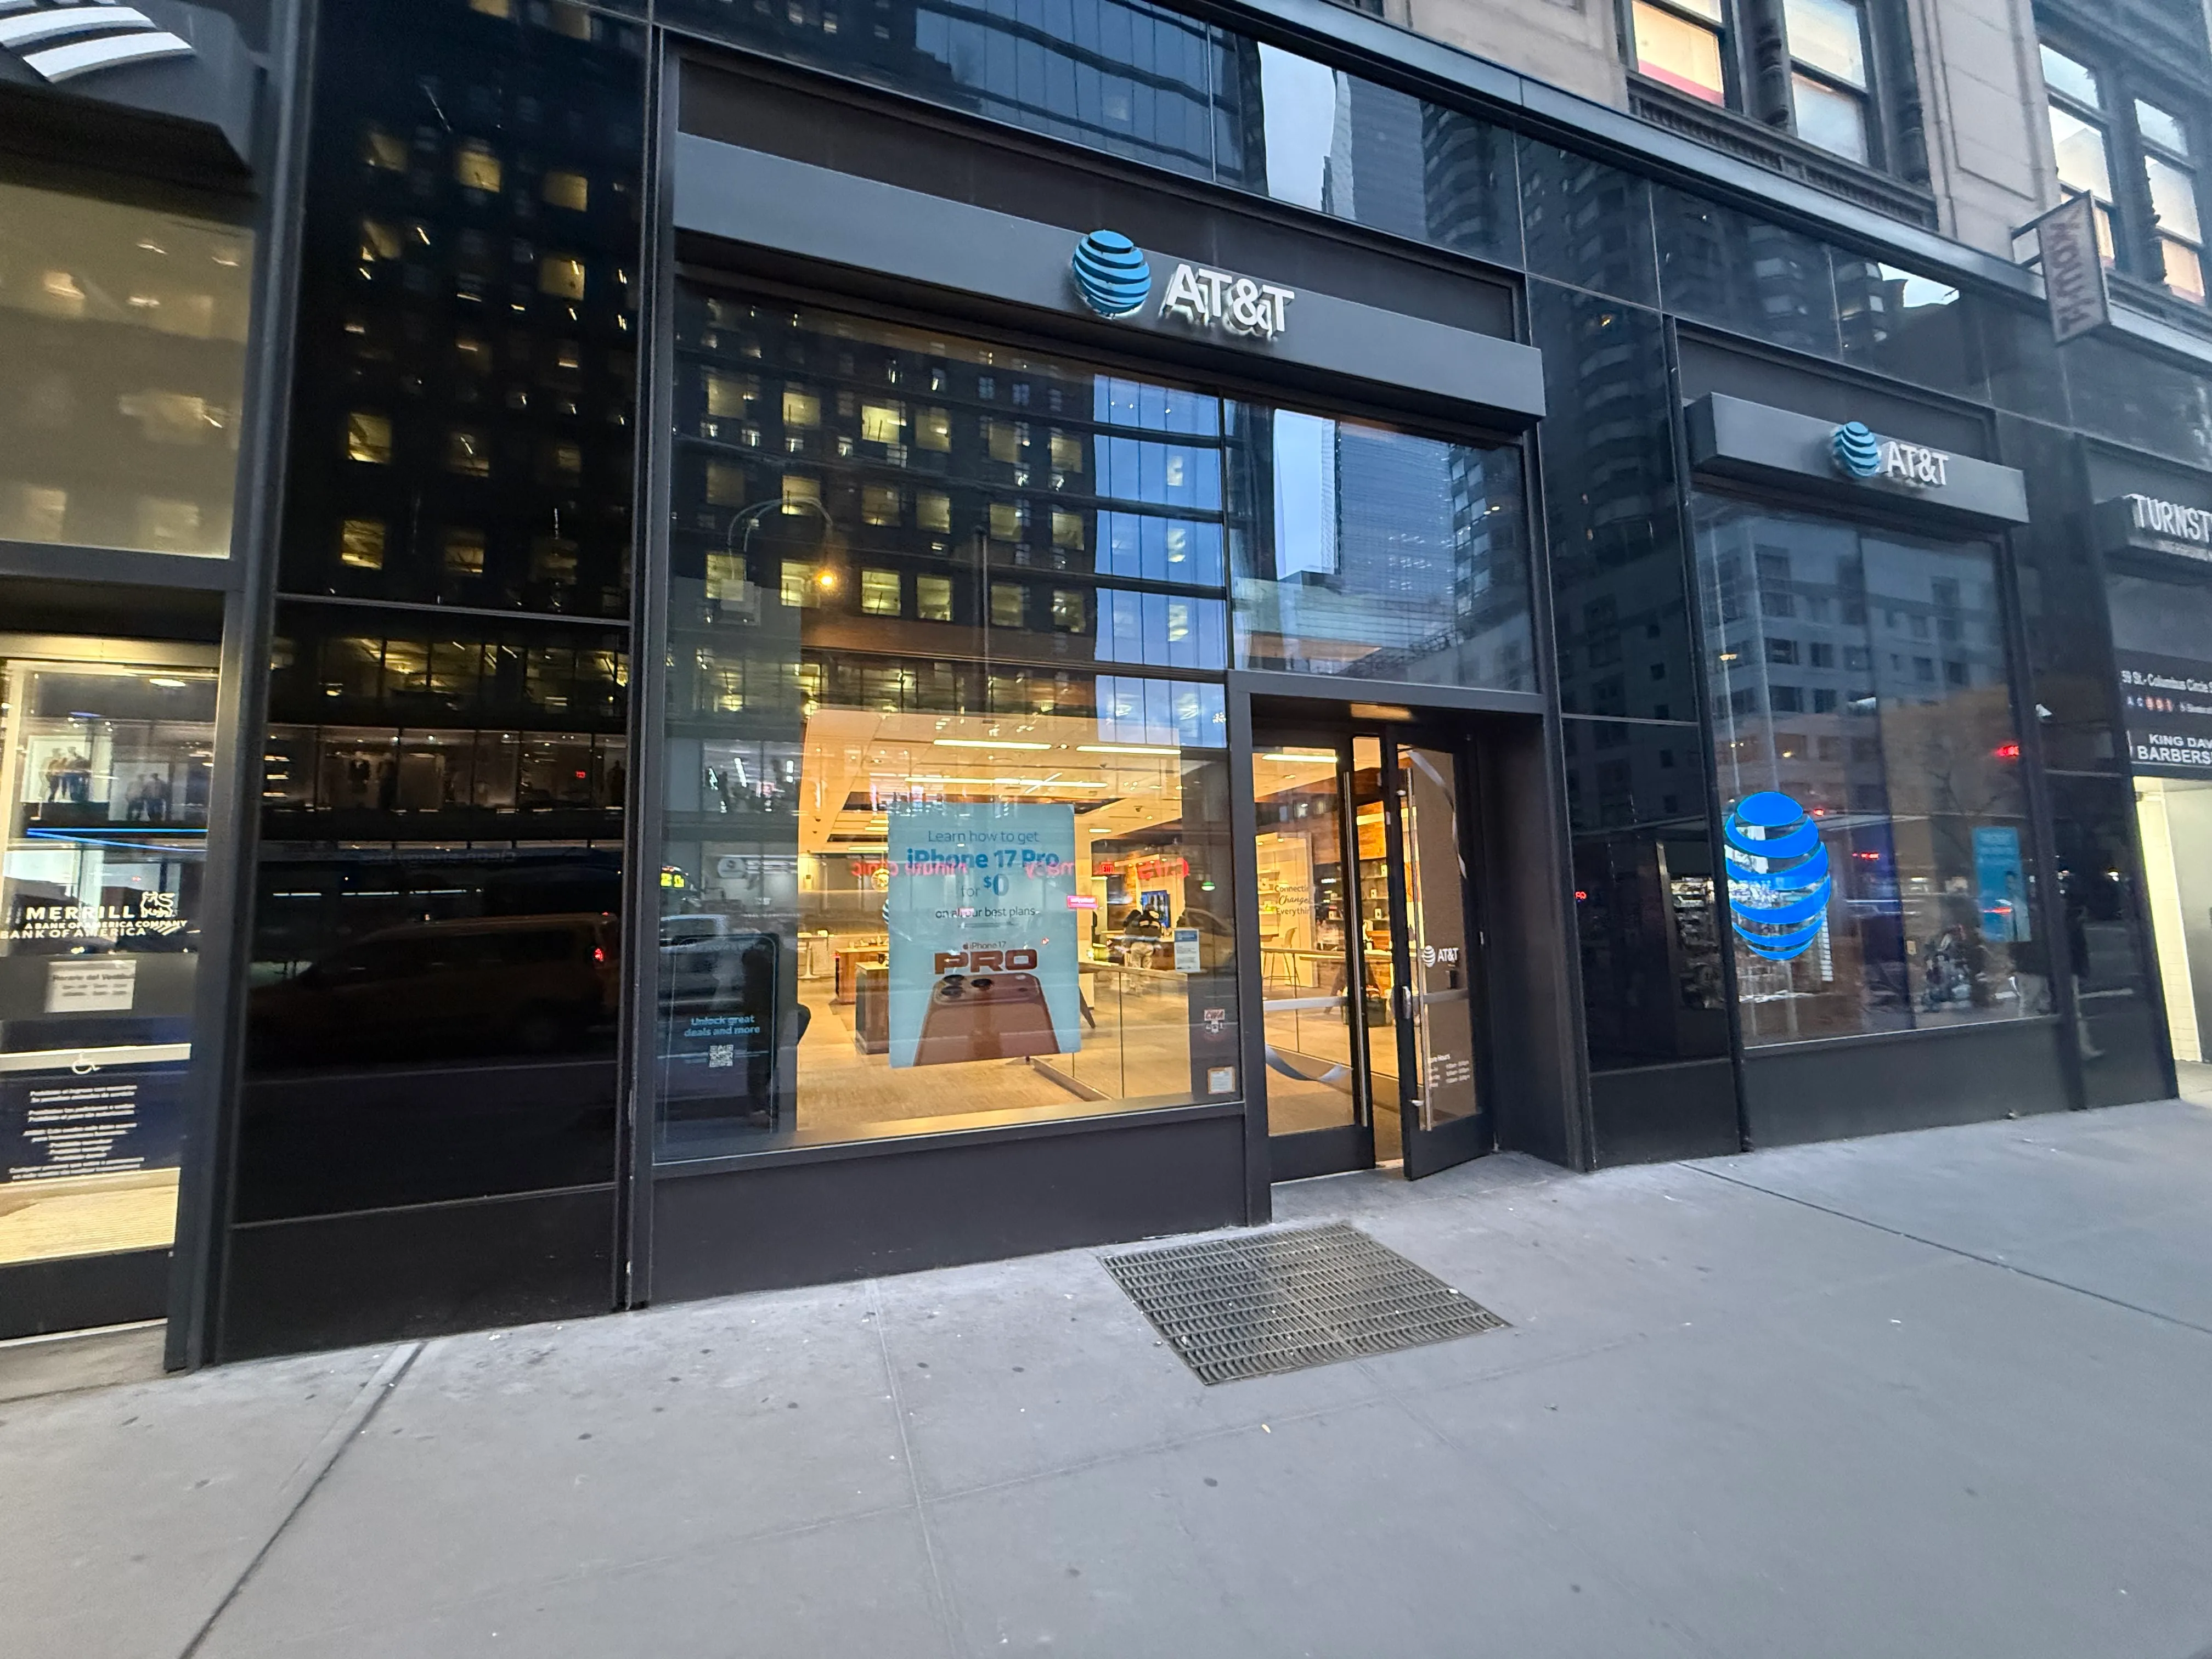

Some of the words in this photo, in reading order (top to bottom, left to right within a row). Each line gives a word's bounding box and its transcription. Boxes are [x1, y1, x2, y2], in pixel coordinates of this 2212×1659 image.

[1163, 263, 1295, 333] AT&T
[1886, 441, 1949, 486] AT&T
[2122, 494, 2212, 543] TURNST
[2149, 733, 2184, 747] KING
[2137, 746, 2212, 765] BARBERS
[928, 831, 966, 842] Learn
[969, 831, 997, 842] how
[1001, 832, 1014, 842] to
[1018, 831, 1040, 844] get
[907, 848, 989, 868] iPhone
[994, 849, 1017, 868] 17
[1021, 849, 1059, 867] Pro
[961, 885, 980, 897] for
[983, 873, 1009, 896] $0
[26, 906, 136, 920] MERRILL
[935, 910, 949, 918] on
[985, 907, 1006, 917] best
[1009, 906, 1036, 918] plans
[25, 922, 33, 930] A
[48, 929, 70, 938] OF
[72, 927, 146, 937] AMERICA
[934, 949, 1038, 975] PRO
[1437, 947, 1459, 962] AT&T
[713, 1026, 732, 1036] and
[734, 1026, 760, 1035] more
